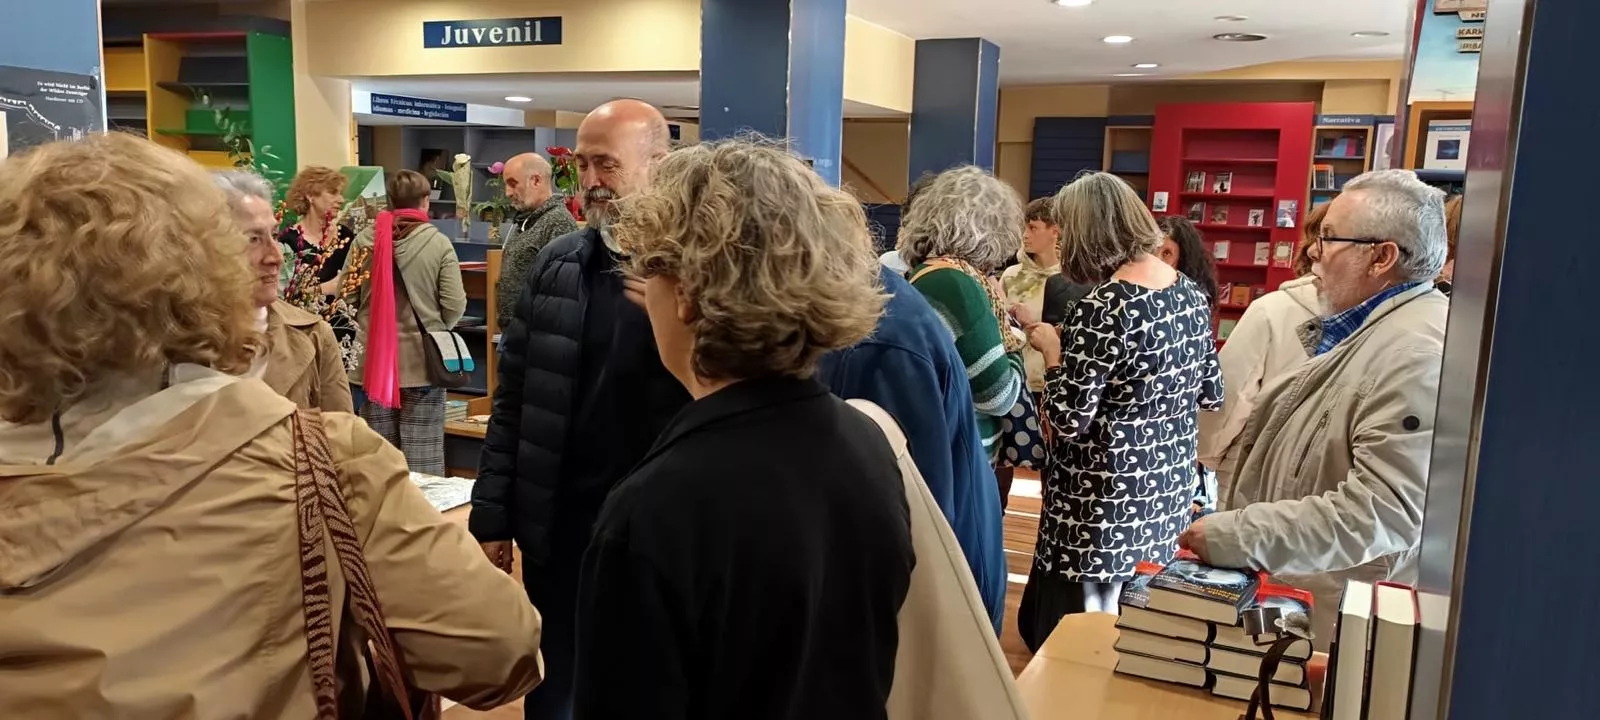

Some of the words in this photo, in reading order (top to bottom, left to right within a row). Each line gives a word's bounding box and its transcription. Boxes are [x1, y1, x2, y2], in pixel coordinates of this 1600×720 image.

[441, 20, 543, 45] Juvenil
[372, 96, 389, 104] Libros
[1323, 116, 1361, 124] Narrativa
